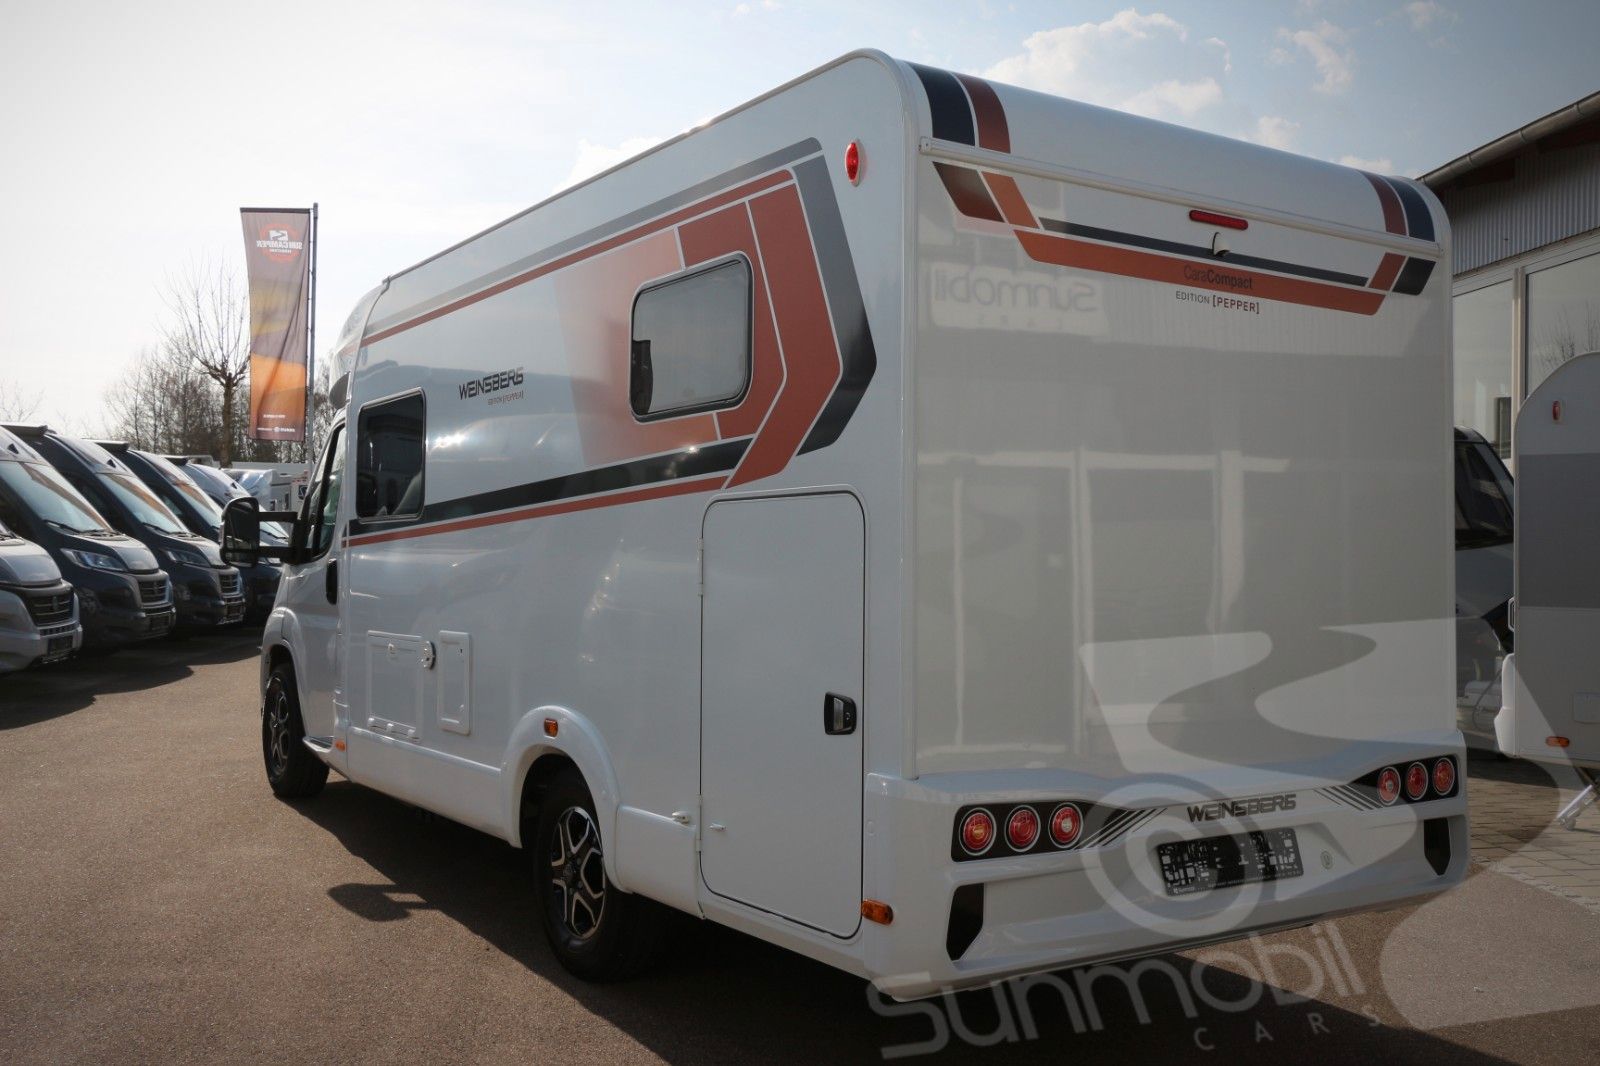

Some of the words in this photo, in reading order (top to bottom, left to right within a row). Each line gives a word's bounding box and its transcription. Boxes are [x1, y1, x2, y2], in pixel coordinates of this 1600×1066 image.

[1184, 265, 1253, 290] CaraCompact
[1176, 290, 1210, 304] EDITION
[1212, 294, 1260, 314] [PEPPER]
[458, 366, 524, 400] WEINSBERG
[1187, 793, 1297, 823] WEINSBERG
